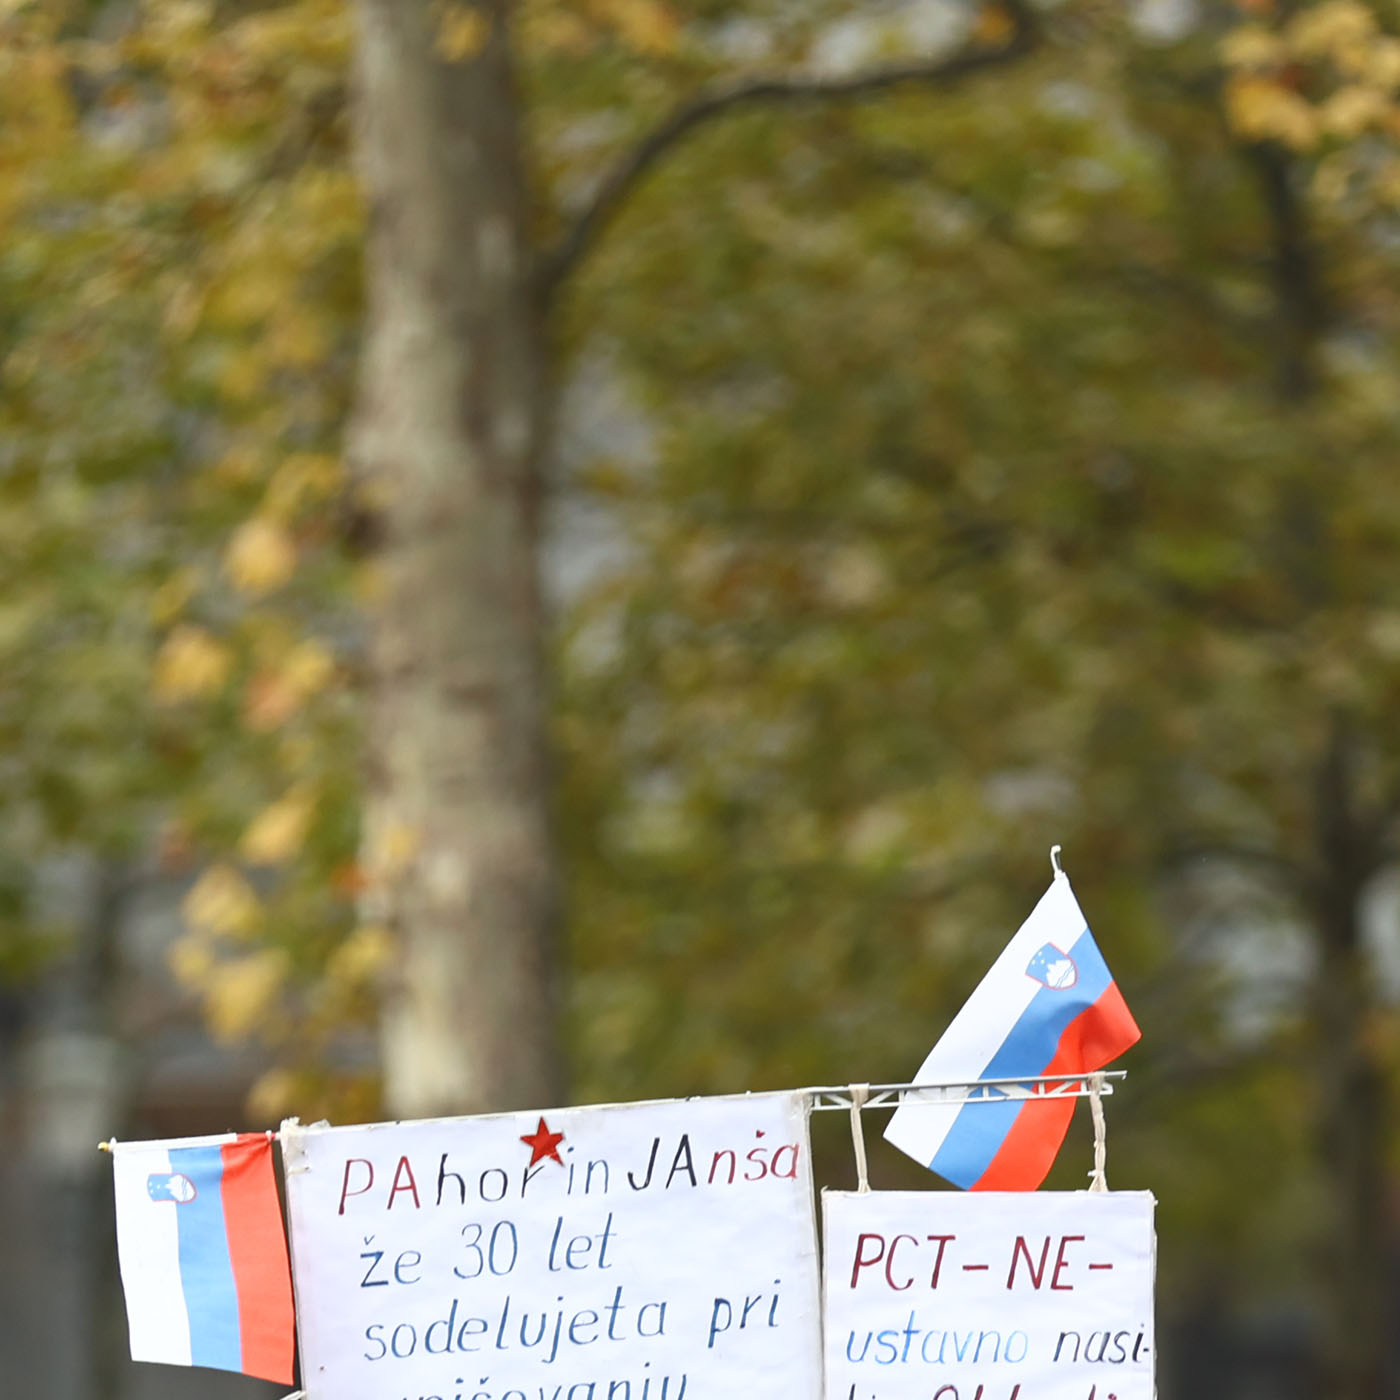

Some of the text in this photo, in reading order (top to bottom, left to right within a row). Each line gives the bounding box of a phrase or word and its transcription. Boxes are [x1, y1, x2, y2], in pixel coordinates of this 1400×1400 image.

[566, 1146, 610, 1196] in
[626, 1129, 801, 1191] JAnša
[359, 1212, 618, 1289] že 30 let
[363, 1279, 782, 1364] sodelujeta pri
[846, 1310, 1030, 1366] ustavno
